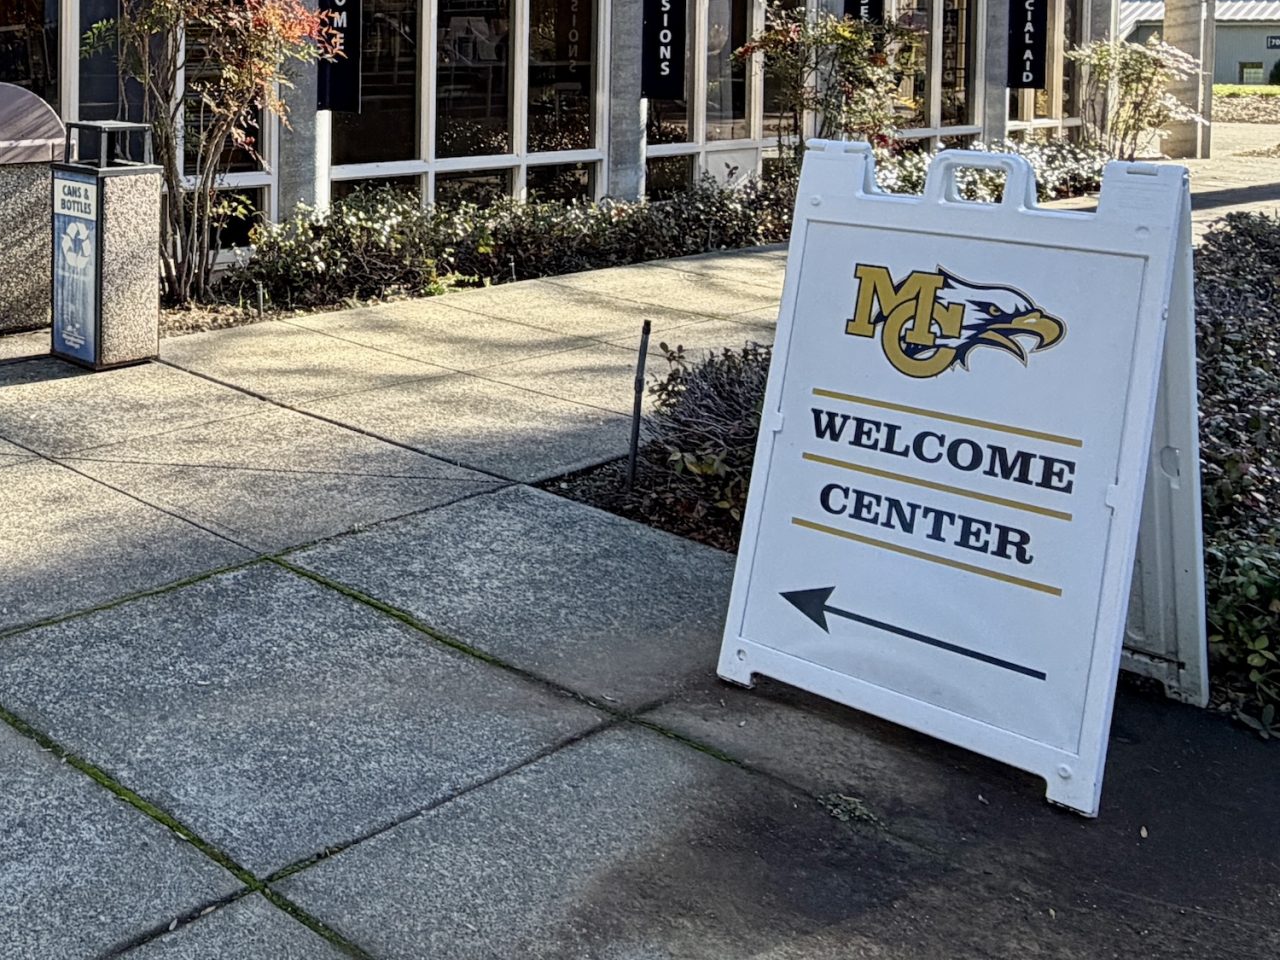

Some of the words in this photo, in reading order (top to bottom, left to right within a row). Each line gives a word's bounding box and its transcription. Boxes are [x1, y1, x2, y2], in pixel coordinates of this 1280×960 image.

[1022, 49, 1034, 83] AID
[60, 198, 92, 215] BOTTLES
[62, 184, 82, 198] CANS
[83, 187, 90, 201] &
[810, 407, 1077, 495] WELCOME
[819, 482, 1035, 565] CENTER
